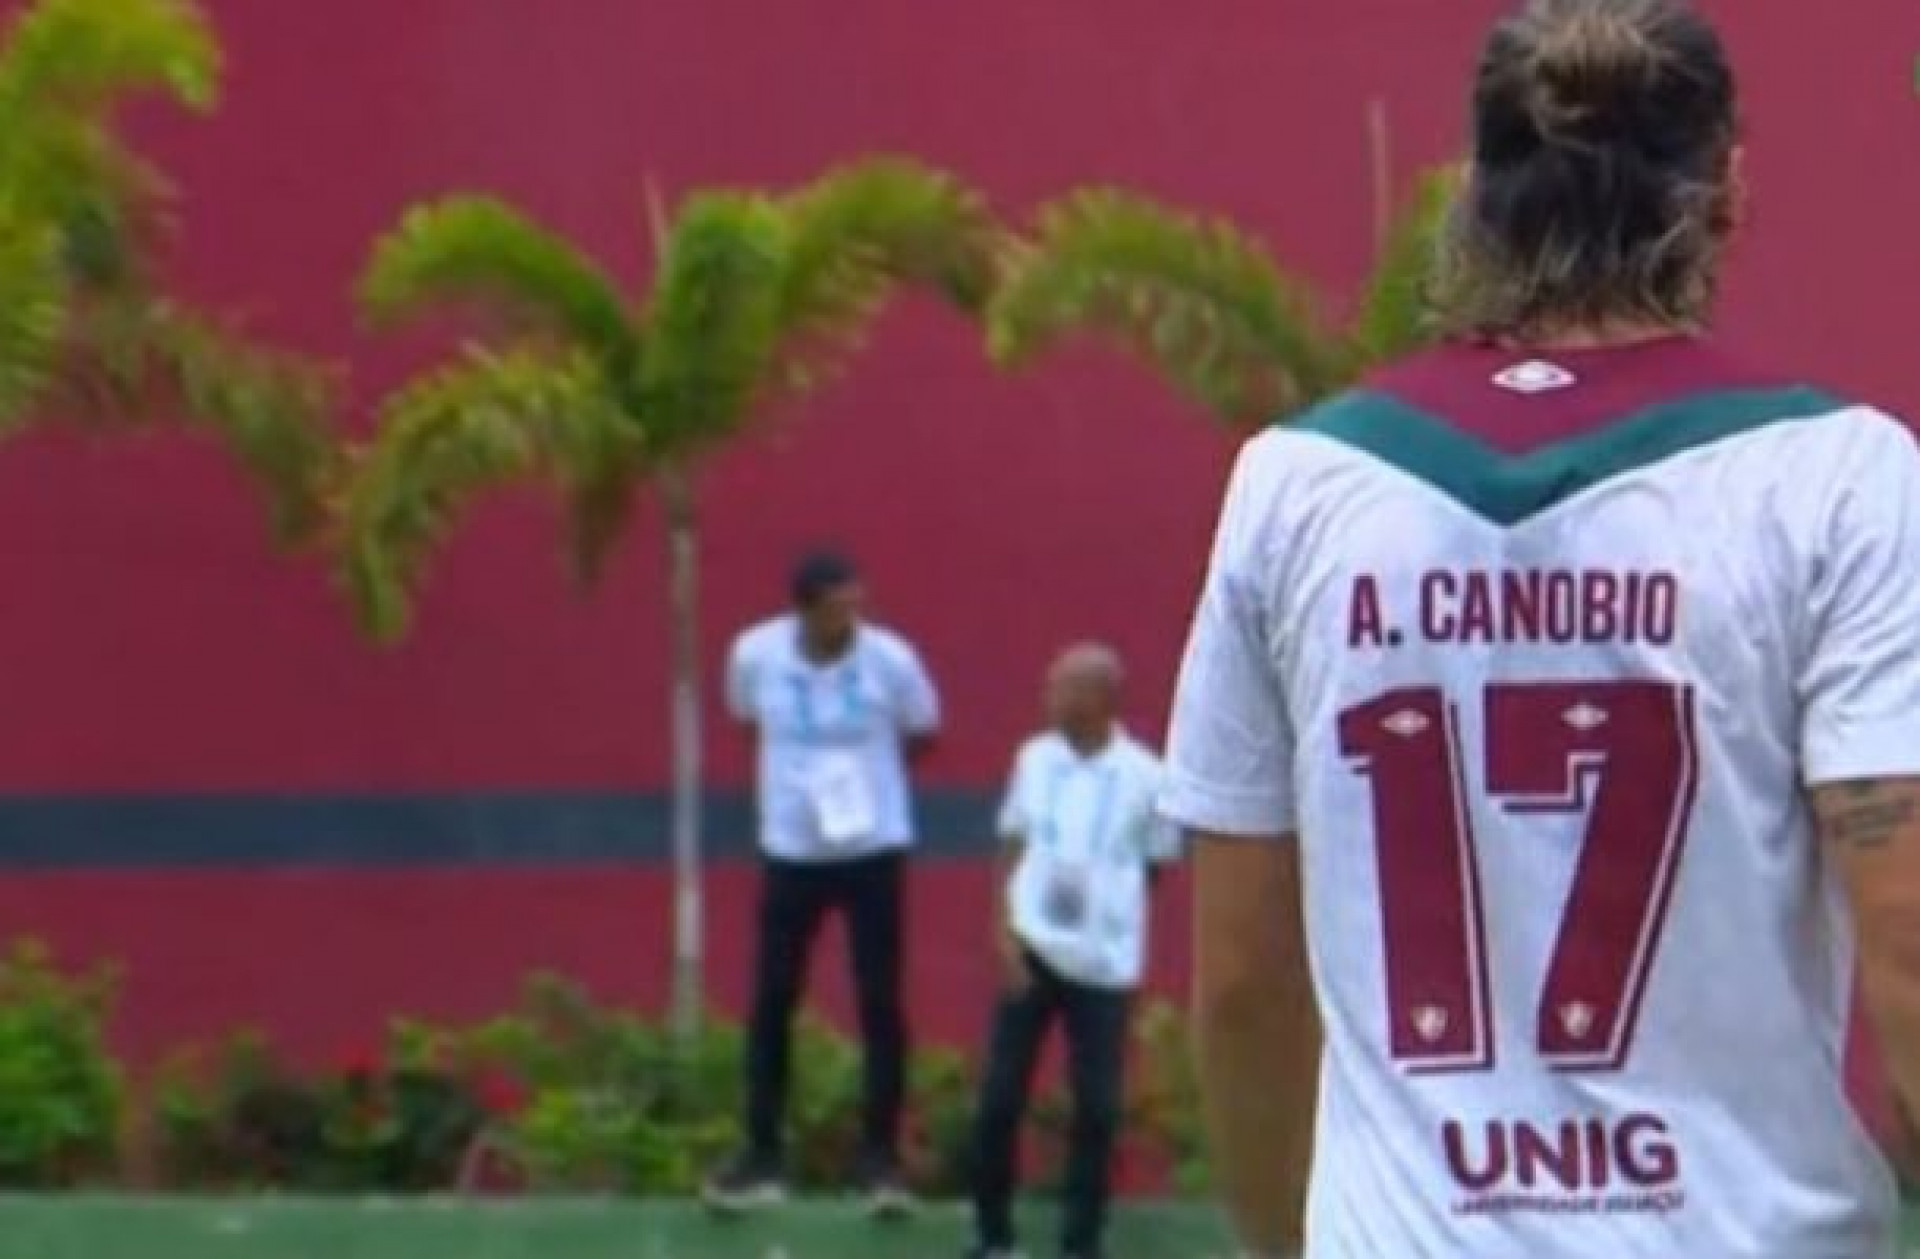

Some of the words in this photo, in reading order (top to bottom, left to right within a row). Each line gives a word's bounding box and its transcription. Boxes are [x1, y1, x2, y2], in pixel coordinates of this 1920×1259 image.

[1347, 574, 1403, 647] A.
[1422, 569, 1677, 647] CANOBIO
[1338, 680, 1698, 1072] 17
[1442, 1112, 1679, 1191] UNIG
